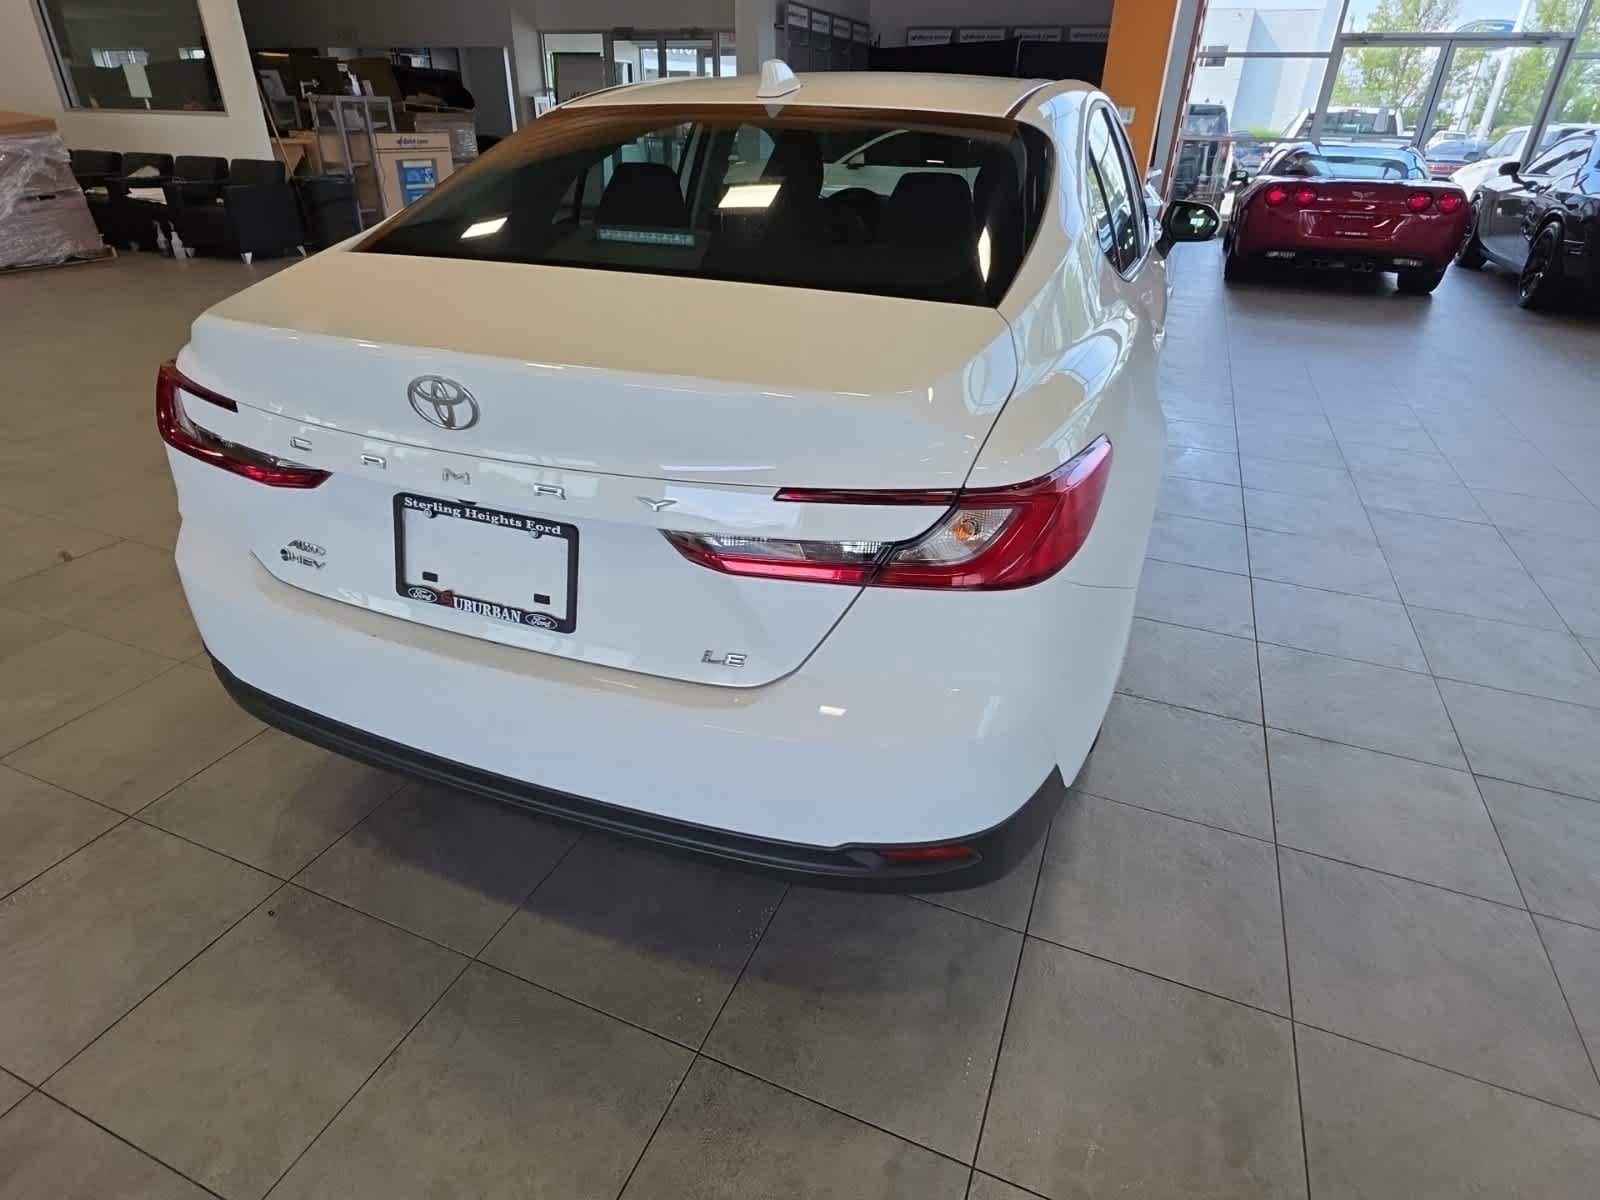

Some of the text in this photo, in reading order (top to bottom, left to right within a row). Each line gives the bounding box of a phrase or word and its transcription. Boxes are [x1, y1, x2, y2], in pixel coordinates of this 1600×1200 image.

[404, 497, 561, 535] Sterling Heights Ford
[411, 587, 436, 602] Ford
[440, 590, 522, 624] SUBURBAN
[527, 614, 555, 629] Ford
[701, 649, 747, 667] LE
